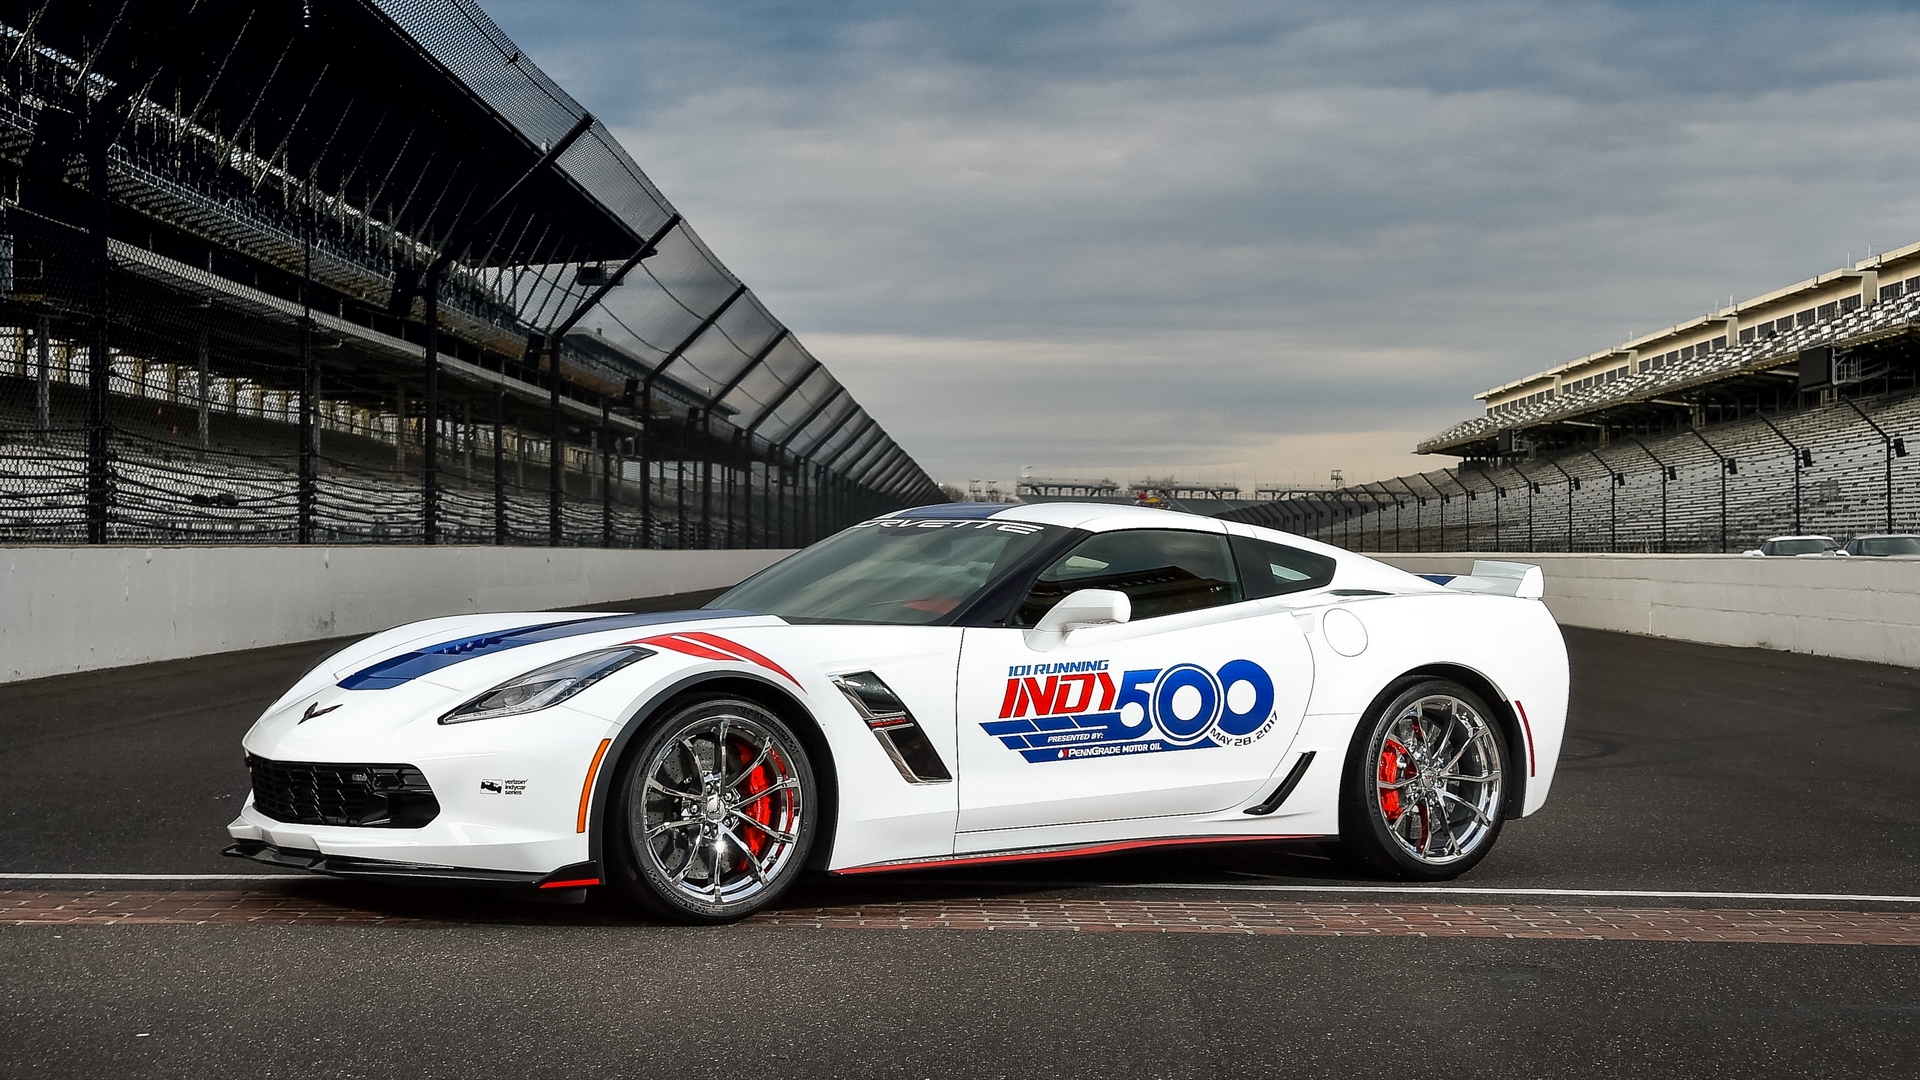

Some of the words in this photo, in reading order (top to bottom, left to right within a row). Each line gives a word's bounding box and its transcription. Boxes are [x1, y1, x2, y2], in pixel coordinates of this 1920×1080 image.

[856, 519, 1045, 535] ORVETTE
[1008, 664, 1032, 677] 101
[1033, 660, 1110, 675] RUNNING
[998, 672, 1117, 719] INDY
[1114, 659, 1275, 746] 500
[1047, 733, 1091, 743] PRESENTED
[1091, 732, 1104, 740] BY:
[1210, 727, 1233, 746] MAY
[1122, 744, 1148, 753] MOTOR
[1149, 743, 1162, 751] OIL
